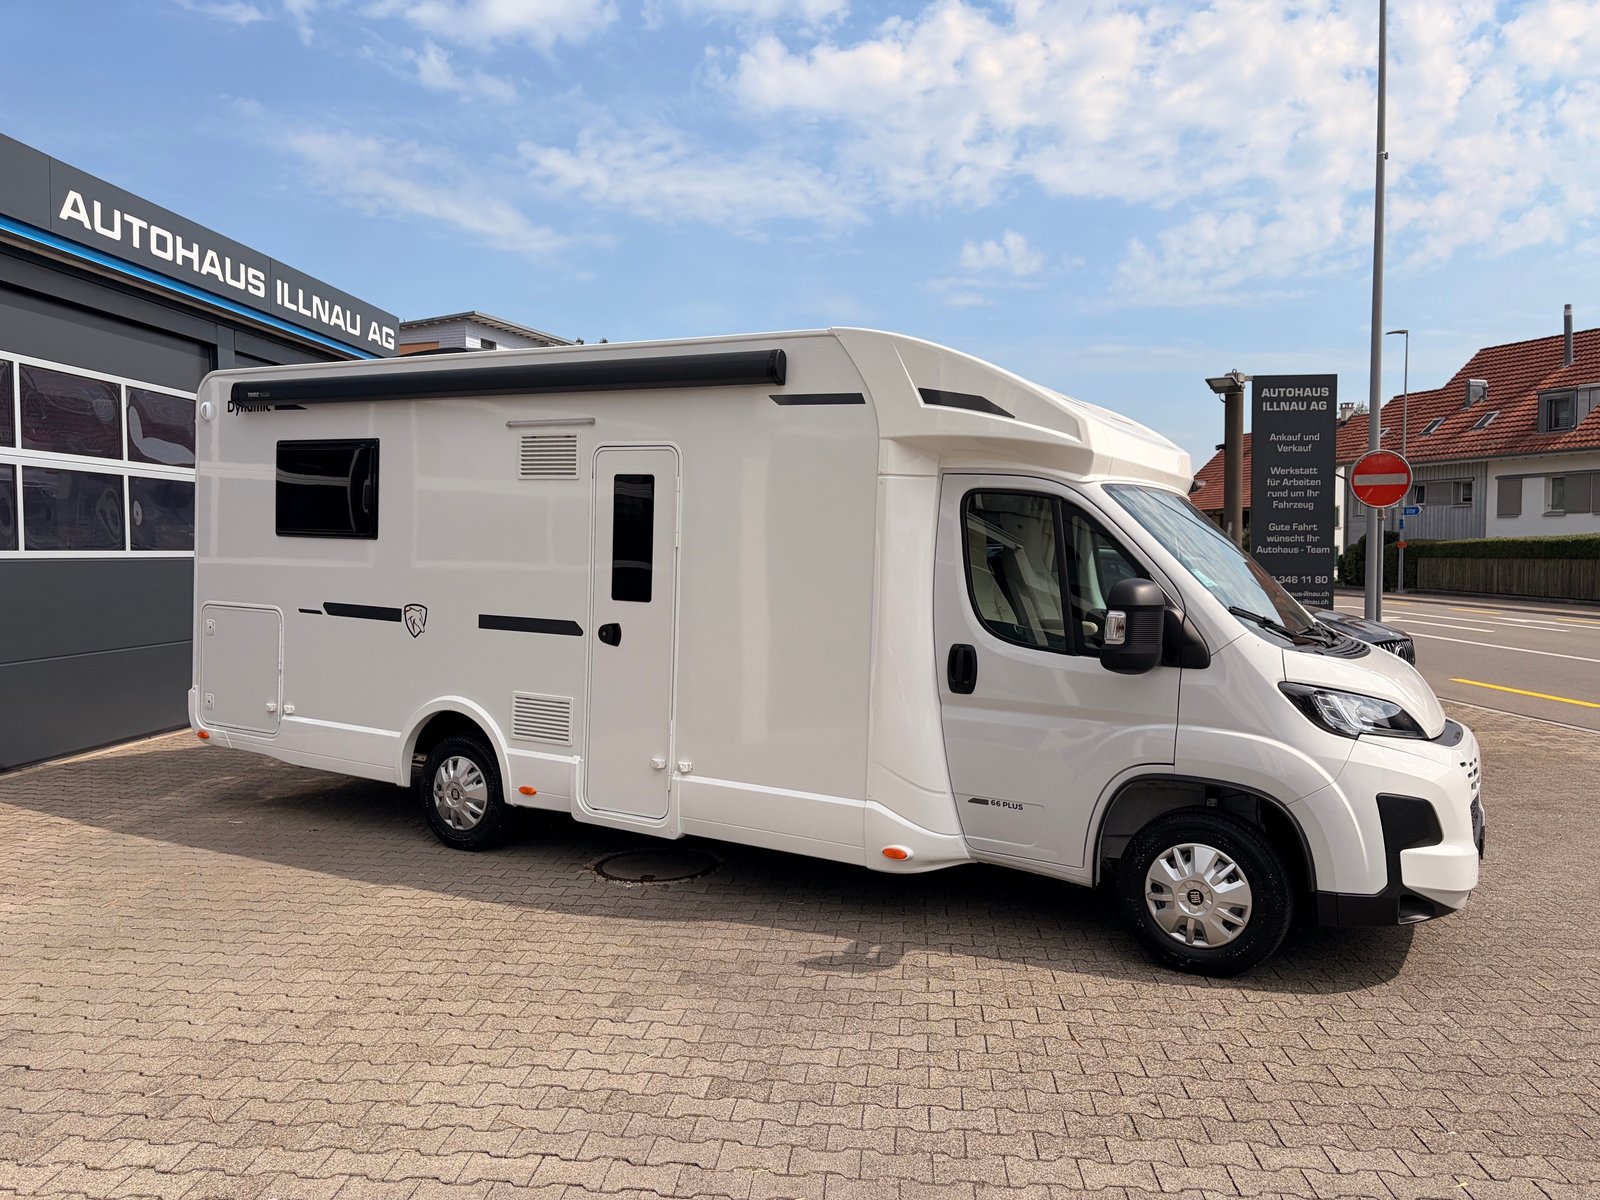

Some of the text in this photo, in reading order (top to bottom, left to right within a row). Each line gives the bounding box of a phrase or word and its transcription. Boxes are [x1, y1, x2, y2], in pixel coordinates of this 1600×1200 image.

[59, 189, 395, 351] AUTOHAUS ILLNAU AG
[1261, 387, 1329, 397] AUTOHAUS
[1262, 401, 1328, 411] ILLNAU AG
[1269, 433, 1320, 441] Ankauf und
[1277, 444, 1312, 452] Verkauf
[1270, 466, 1318, 475] Werkstatt
[1267, 478, 1321, 486] für Arbeiten
[1267, 489, 1288, 497] rund
[1306, 489, 1320, 497] Ihr
[1273, 500, 1314, 510] Fahrzeug
[1268, 523, 1318, 531] Gute Fahrt
[1266, 534, 1320, 542] wünscht Ihr
[1256, 545, 1299, 554] Autohaus
[1306, 545, 1330, 554] Team
[1279, 575, 1298, 584] 346
[1300, 575, 1312, 584] 11
[1315, 575, 1328, 584] 80
[1002, 801, 1023, 810] PLUS
